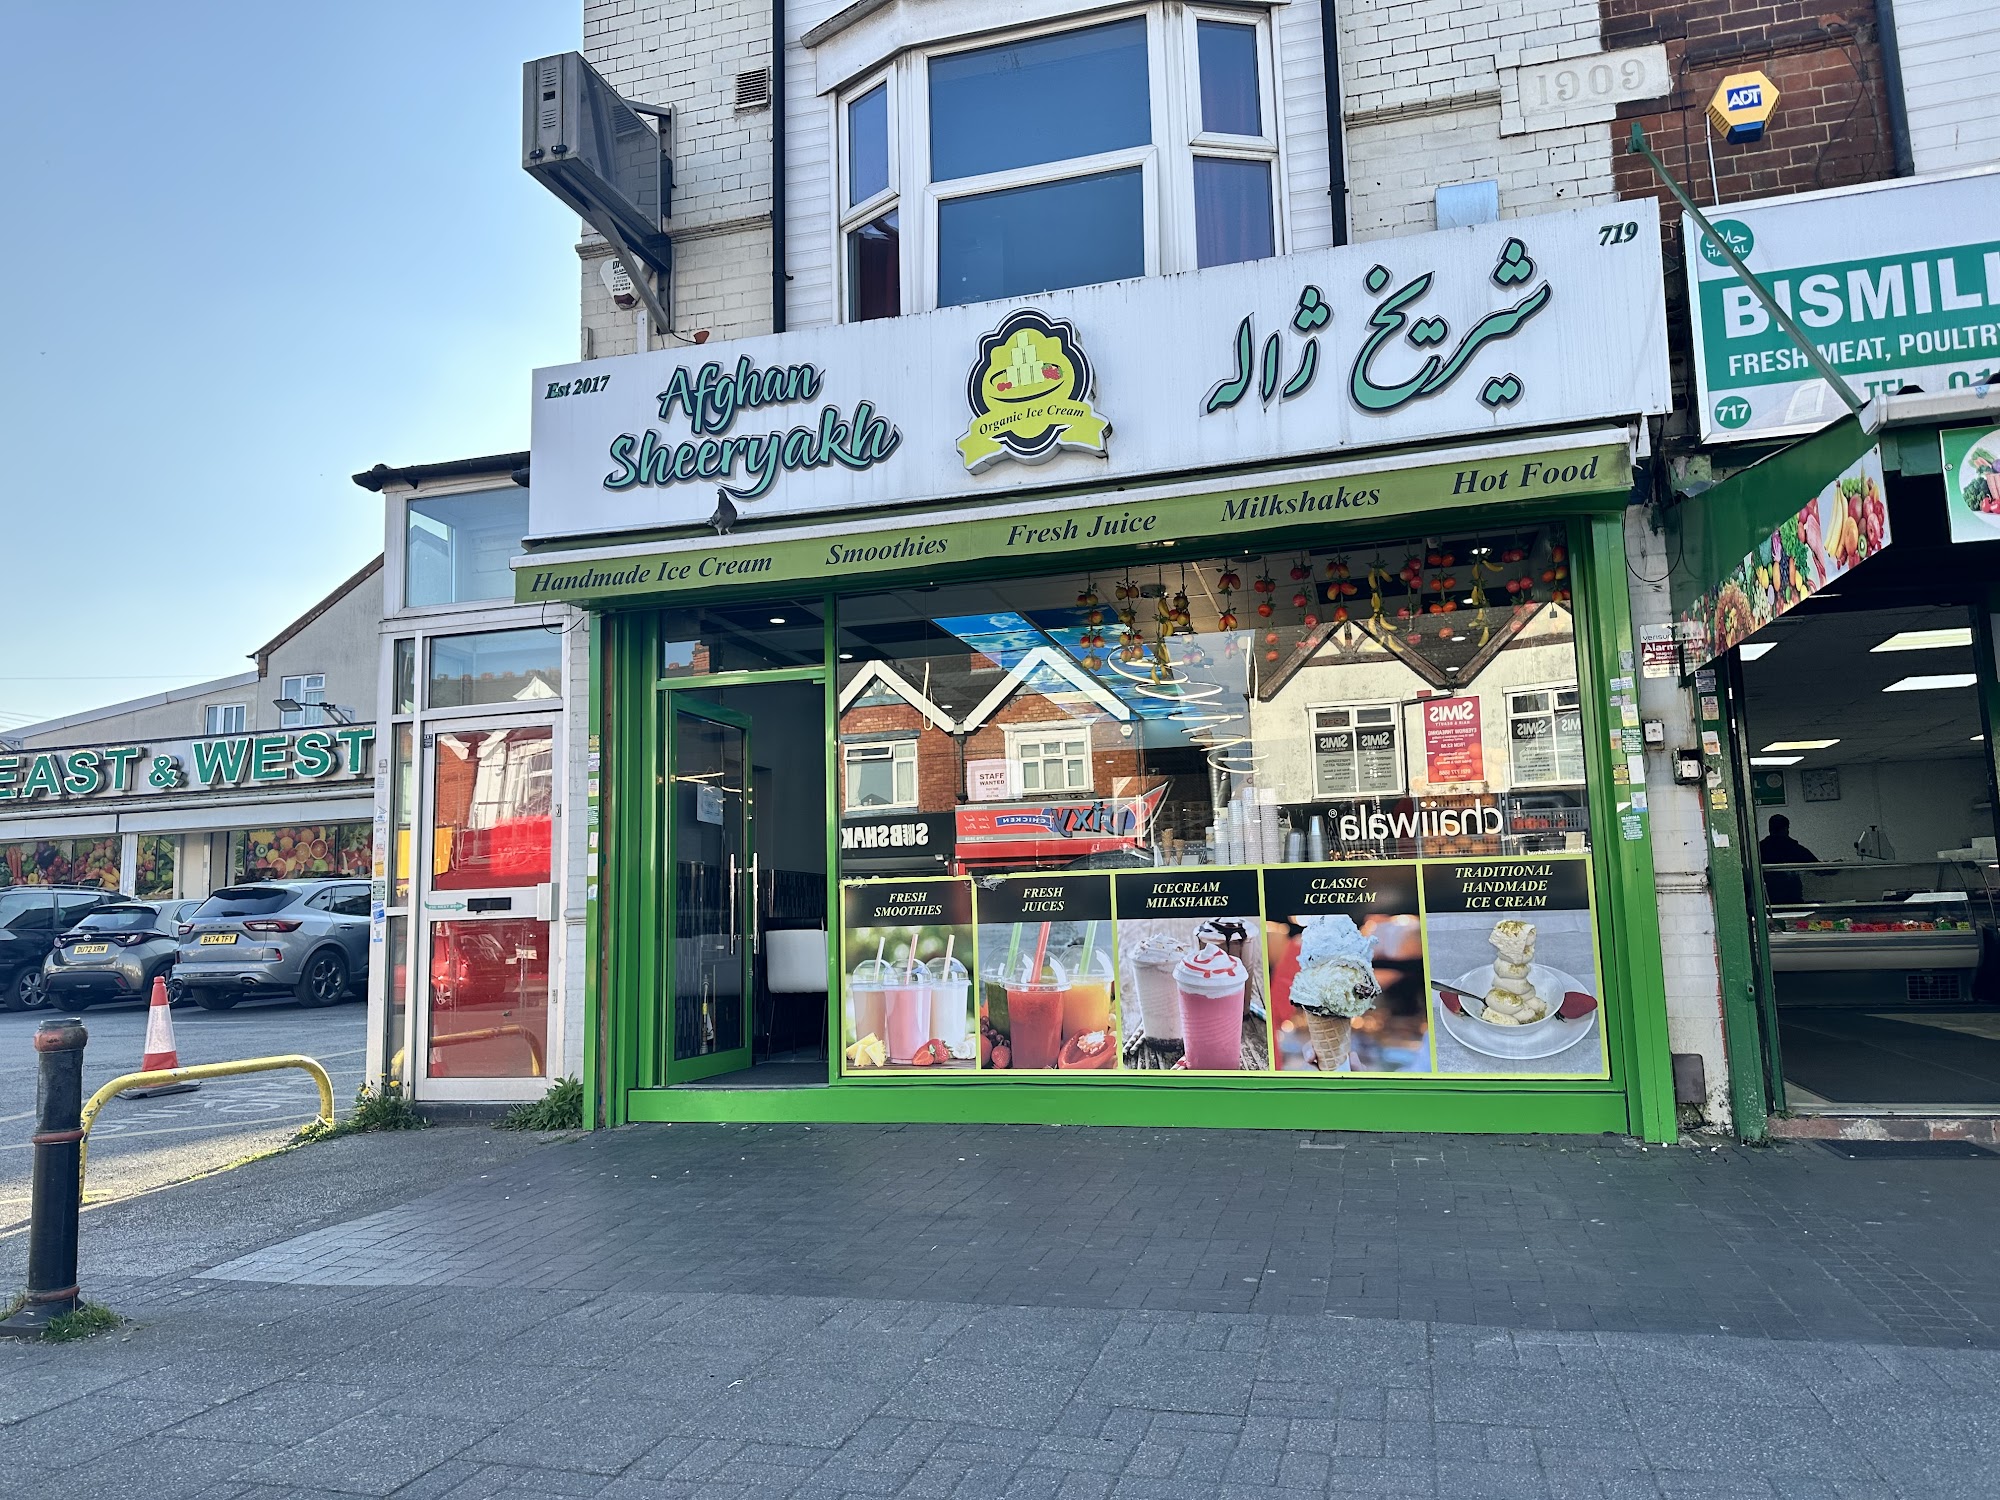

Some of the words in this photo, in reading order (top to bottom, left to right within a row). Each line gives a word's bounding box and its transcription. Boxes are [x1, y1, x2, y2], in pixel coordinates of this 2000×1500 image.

[1728, 87, 1761, 111] ADT
[1598, 221, 1639, 247] 719
[1728, 348, 1809, 377] FRESH
[1815, 337, 1891, 371] MEAT,
[544, 380, 571, 400] Est
[572, 374, 611, 396] 2017
[656, 353, 826, 437] Afghan
[979, 411, 1023, 435] Organic
[1026, 407, 1043, 419] Ice
[1047, 404, 1085, 418] Cream
[1716, 403, 1749, 422] 717
[602, 400, 903, 502] Sheeryakh
[1452, 468, 1510, 496] Hot
[1518, 456, 1600, 489] Food
[1220, 485, 1381, 524] Milkshakes
[1006, 518, 1079, 547] Fresh
[1086, 511, 1158, 541] Juice
[825, 535, 949, 566] Smoothies
[530, 563, 651, 593] Handmade
[656, 560, 692, 582] Ice
[698, 556, 772, 579] Cream
[148, 754, 180, 789] &
[192, 727, 376, 786] WEST
[979, 772, 1005, 780] STAFF
[1454, 864, 1554, 878] TRADITIONAL
[1022, 886, 1064, 899] FRESH
[1152, 881, 1221, 895] ICECREAM
[1311, 877, 1368, 890] CLASSIC
[1461, 879, 1548, 893] HANDMADE
[888, 891, 928, 904] FRESH
[1021, 900, 1065, 913] JUICES
[1145, 895, 1229, 909] MILKSHAKES
[1303, 891, 1377, 905] ICECREAM
[1465, 896, 1491, 908] ICE
[1494, 894, 1547, 908] CREAM
[873, 903, 943, 918] SMOOTHIES
[203, 935, 220, 944] BX74
[221, 935, 234, 943] TFY
